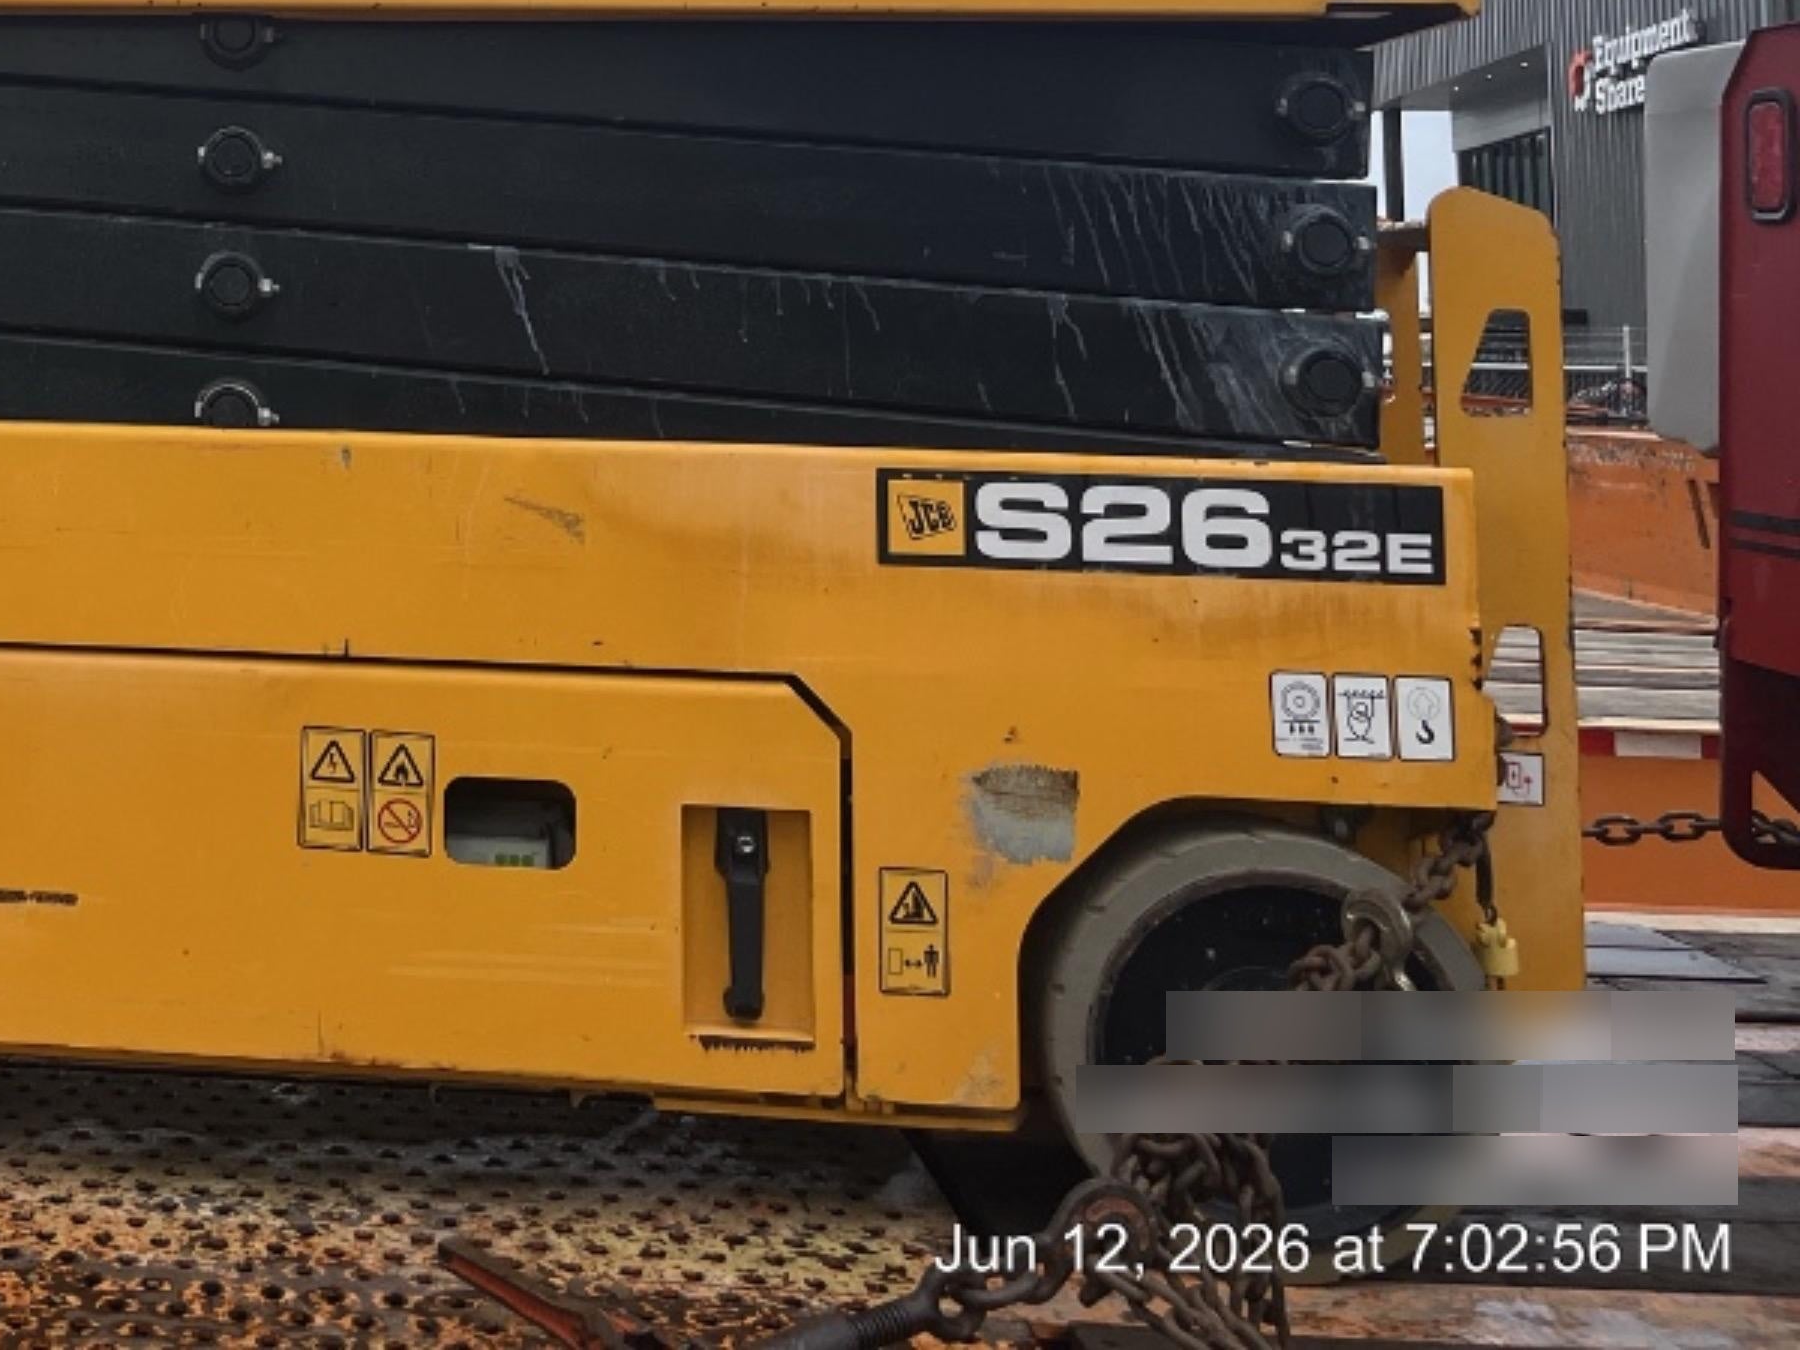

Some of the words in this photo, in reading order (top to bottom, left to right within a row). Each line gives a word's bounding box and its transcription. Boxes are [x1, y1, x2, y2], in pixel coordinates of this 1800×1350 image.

[1592, 8, 1691, 75] Equipment
[1594, 74, 1645, 114] Share
[908, 500, 952, 534] JCB
[974, 482, 1273, 569] S26
[1279, 530, 1433, 575] 32E
